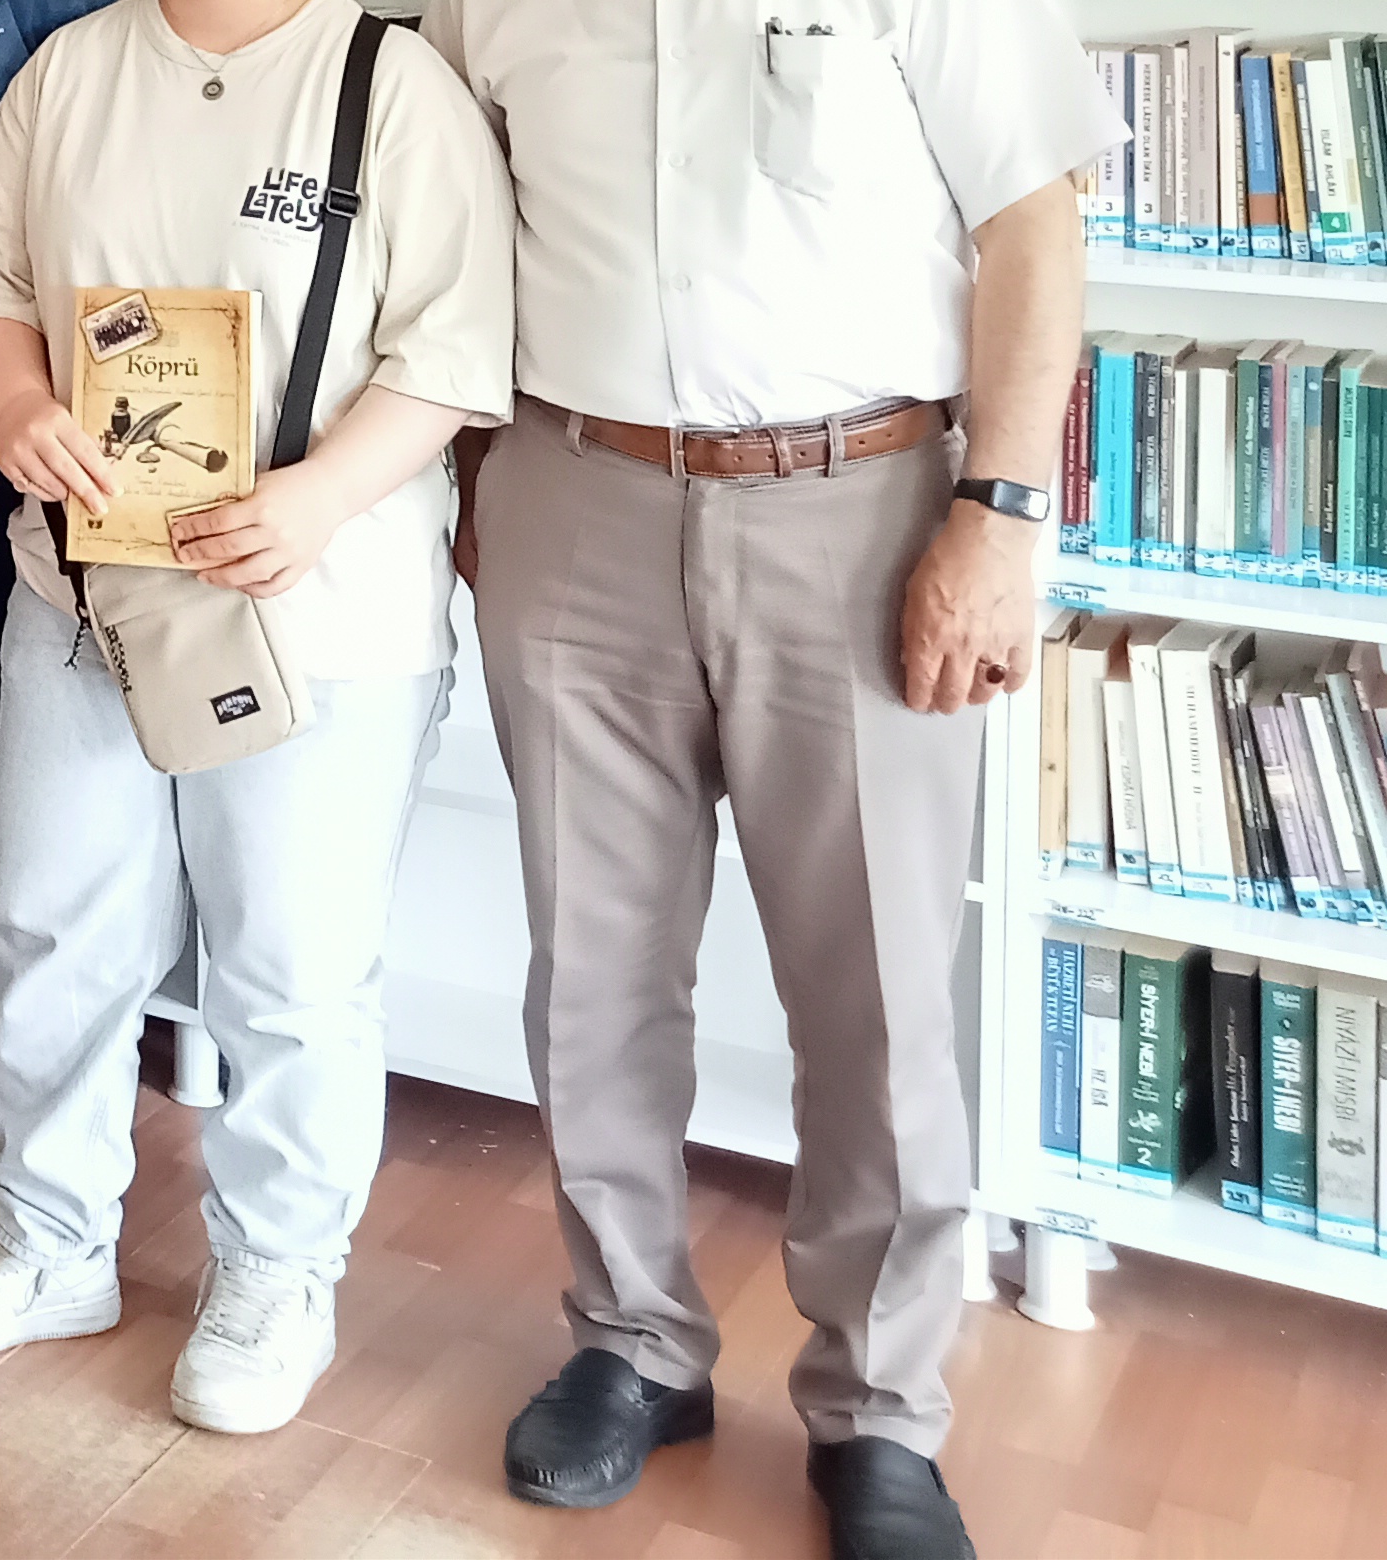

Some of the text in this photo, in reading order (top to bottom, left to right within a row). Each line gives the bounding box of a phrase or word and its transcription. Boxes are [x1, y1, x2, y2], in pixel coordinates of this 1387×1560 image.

[1142, 63, 1152, 103] HERKESE
[124, 352, 200, 383] Köprü
[1138, 1041, 1158, 1078] NEBİ
[1136, 1147, 1153, 1168] 2
